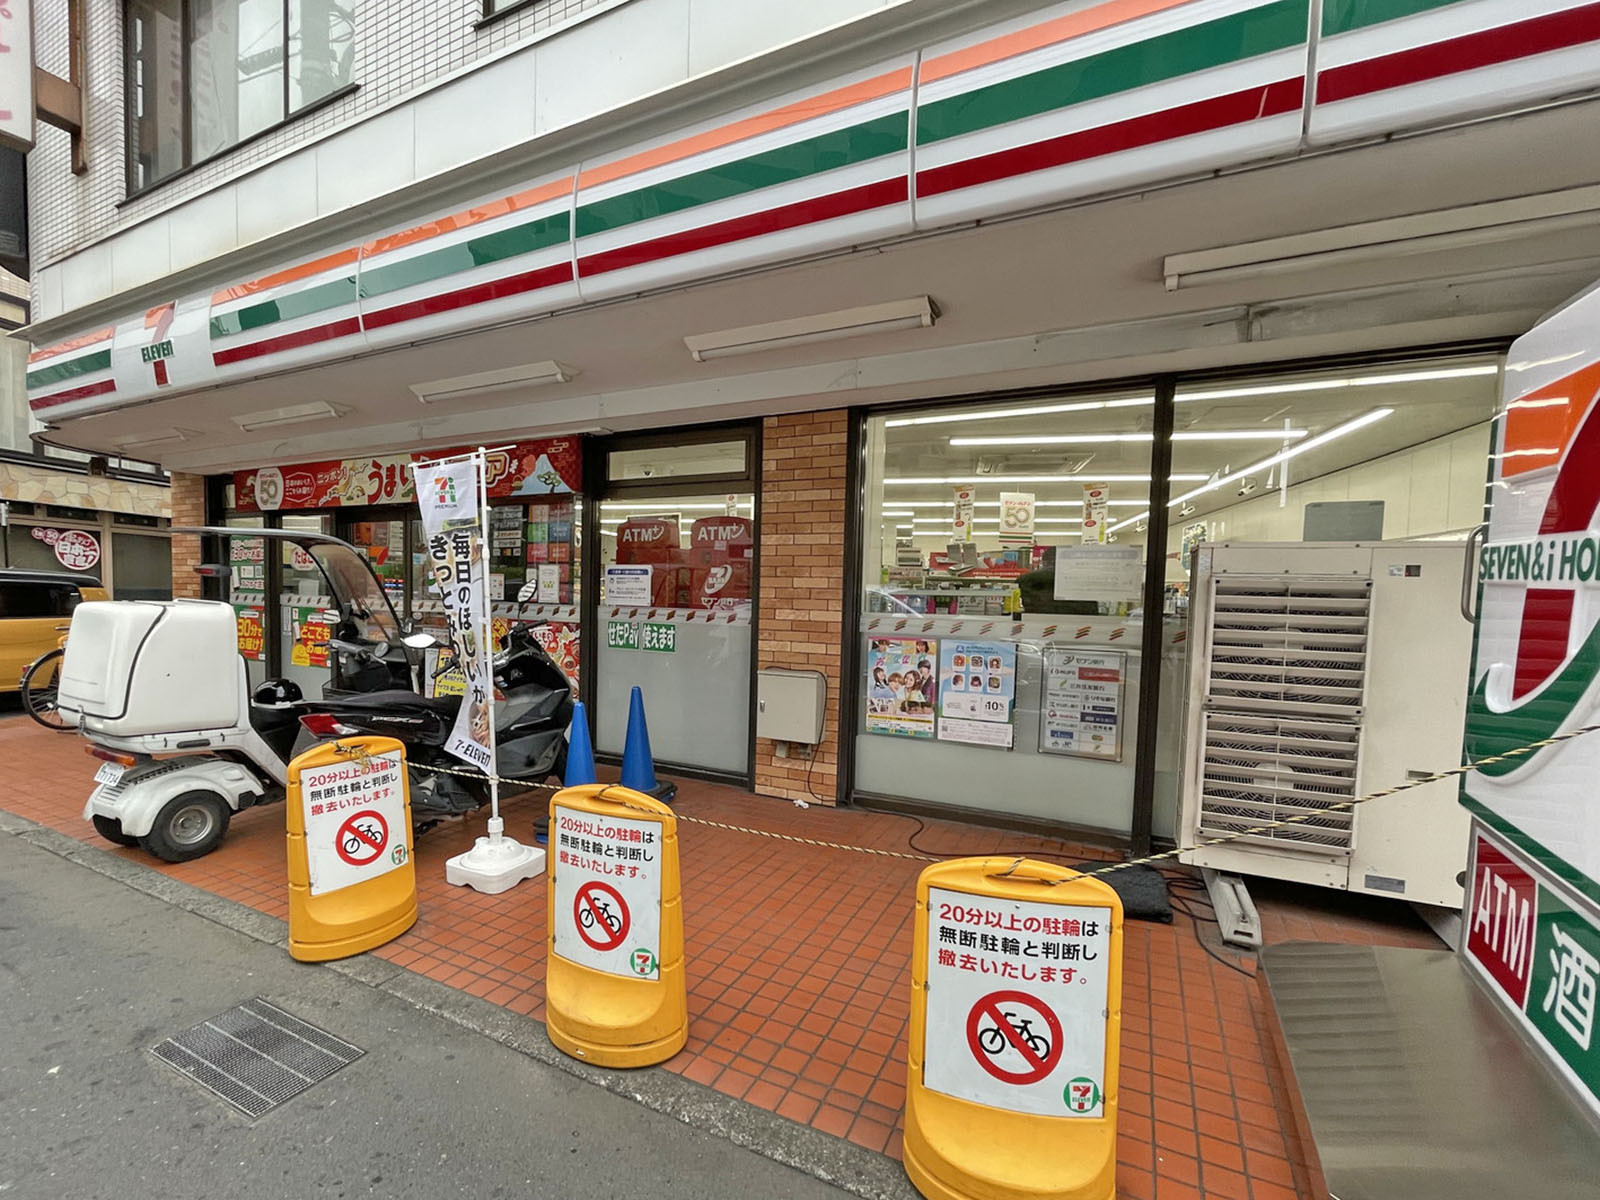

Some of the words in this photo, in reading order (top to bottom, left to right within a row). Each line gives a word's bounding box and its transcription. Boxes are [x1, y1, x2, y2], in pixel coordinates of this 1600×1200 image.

[1004, 506, 1030, 529] 50
[623, 528, 653, 543] ATM
[698, 526, 731, 541] ATM
[238, 618, 262, 636] 30分で
[301, 626, 331, 640] どこでも
[608, 621, 639, 647] せたPay
[642, 624, 676, 650] 使えます
[309, 760, 397, 788] 20分以上の駐輪は
[310, 772, 398, 802] 無断駐輪と判断し
[311, 788, 396, 816] 撤去いたします。
[560, 816, 654, 844] 20分以上の駐輪は
[559, 833, 654, 862] 無断駐輪と判断し
[559, 850, 648, 880] 撤去いたします。
[939, 903, 1099, 938] 20分以上の駐輪は
[1474, 866, 1529, 980] ATM
[939, 926, 1098, 961] 無断駐輪と判断し
[937, 947, 1088, 985] 撤去いたします。
[1543, 922, 1600, 1051] 酒
